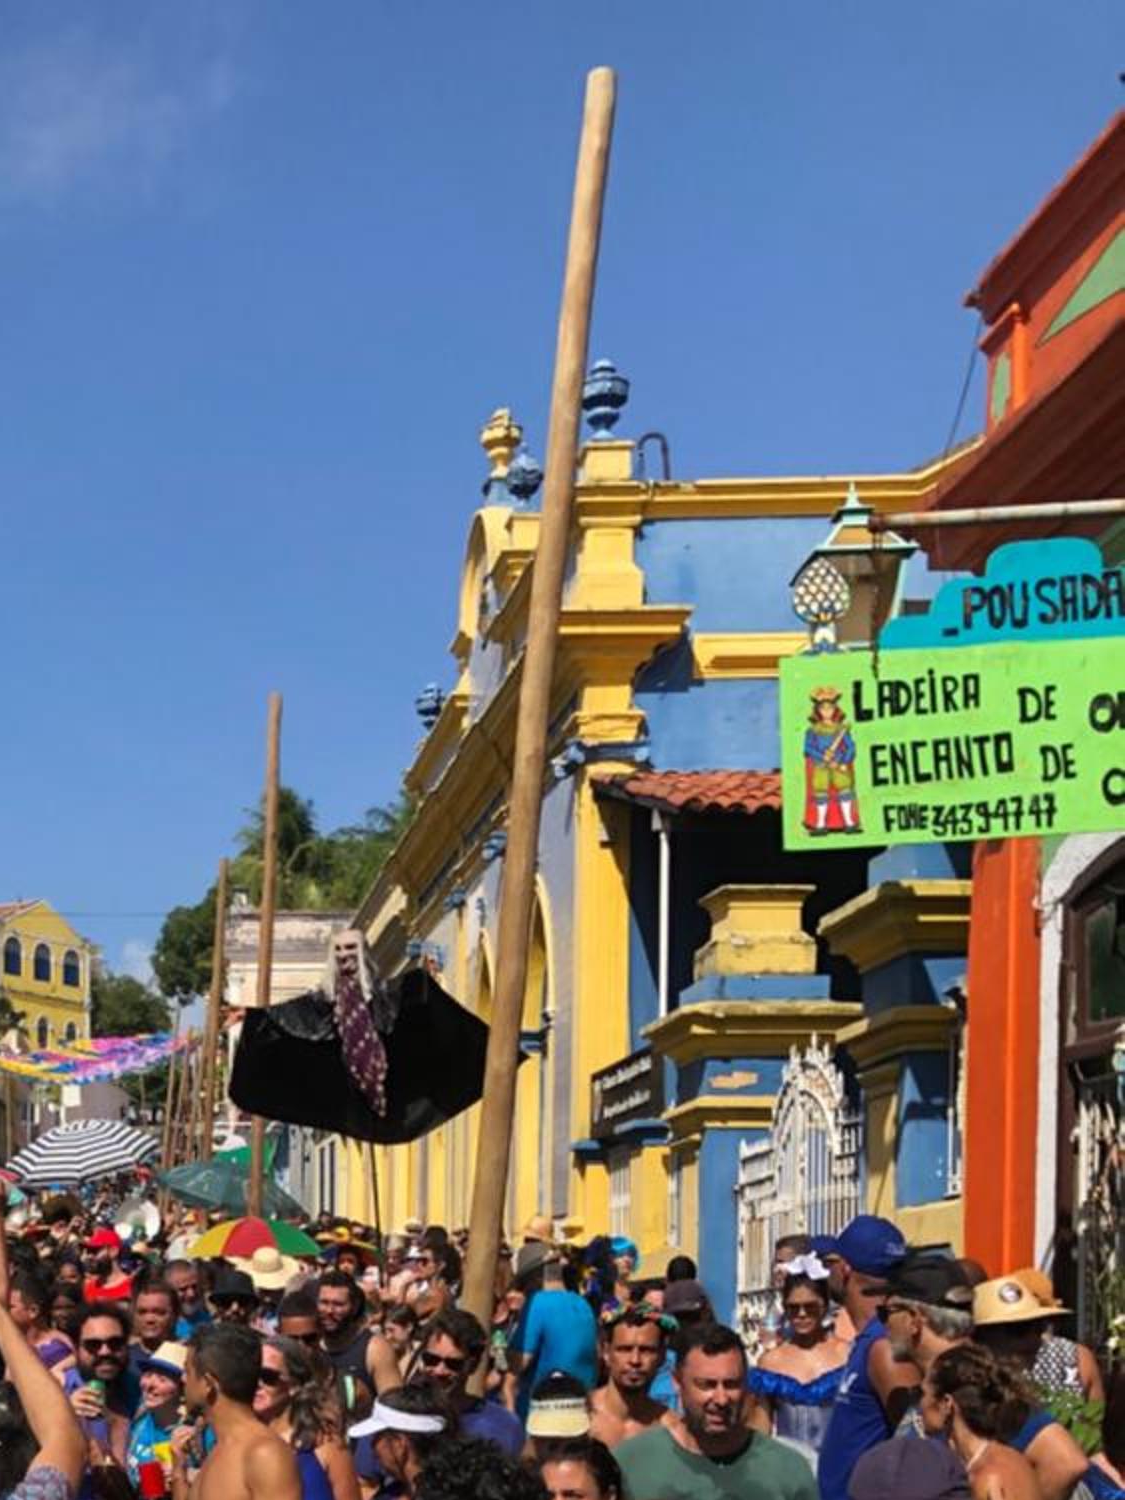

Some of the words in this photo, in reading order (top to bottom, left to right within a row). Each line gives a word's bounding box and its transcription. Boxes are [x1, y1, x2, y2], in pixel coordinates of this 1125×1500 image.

[962, 570, 1125, 630] POUSADA
[1018, 684, 1057, 724] DE
[870, 731, 1015, 788] ENCANTO
[1040, 742, 1078, 783] DE
